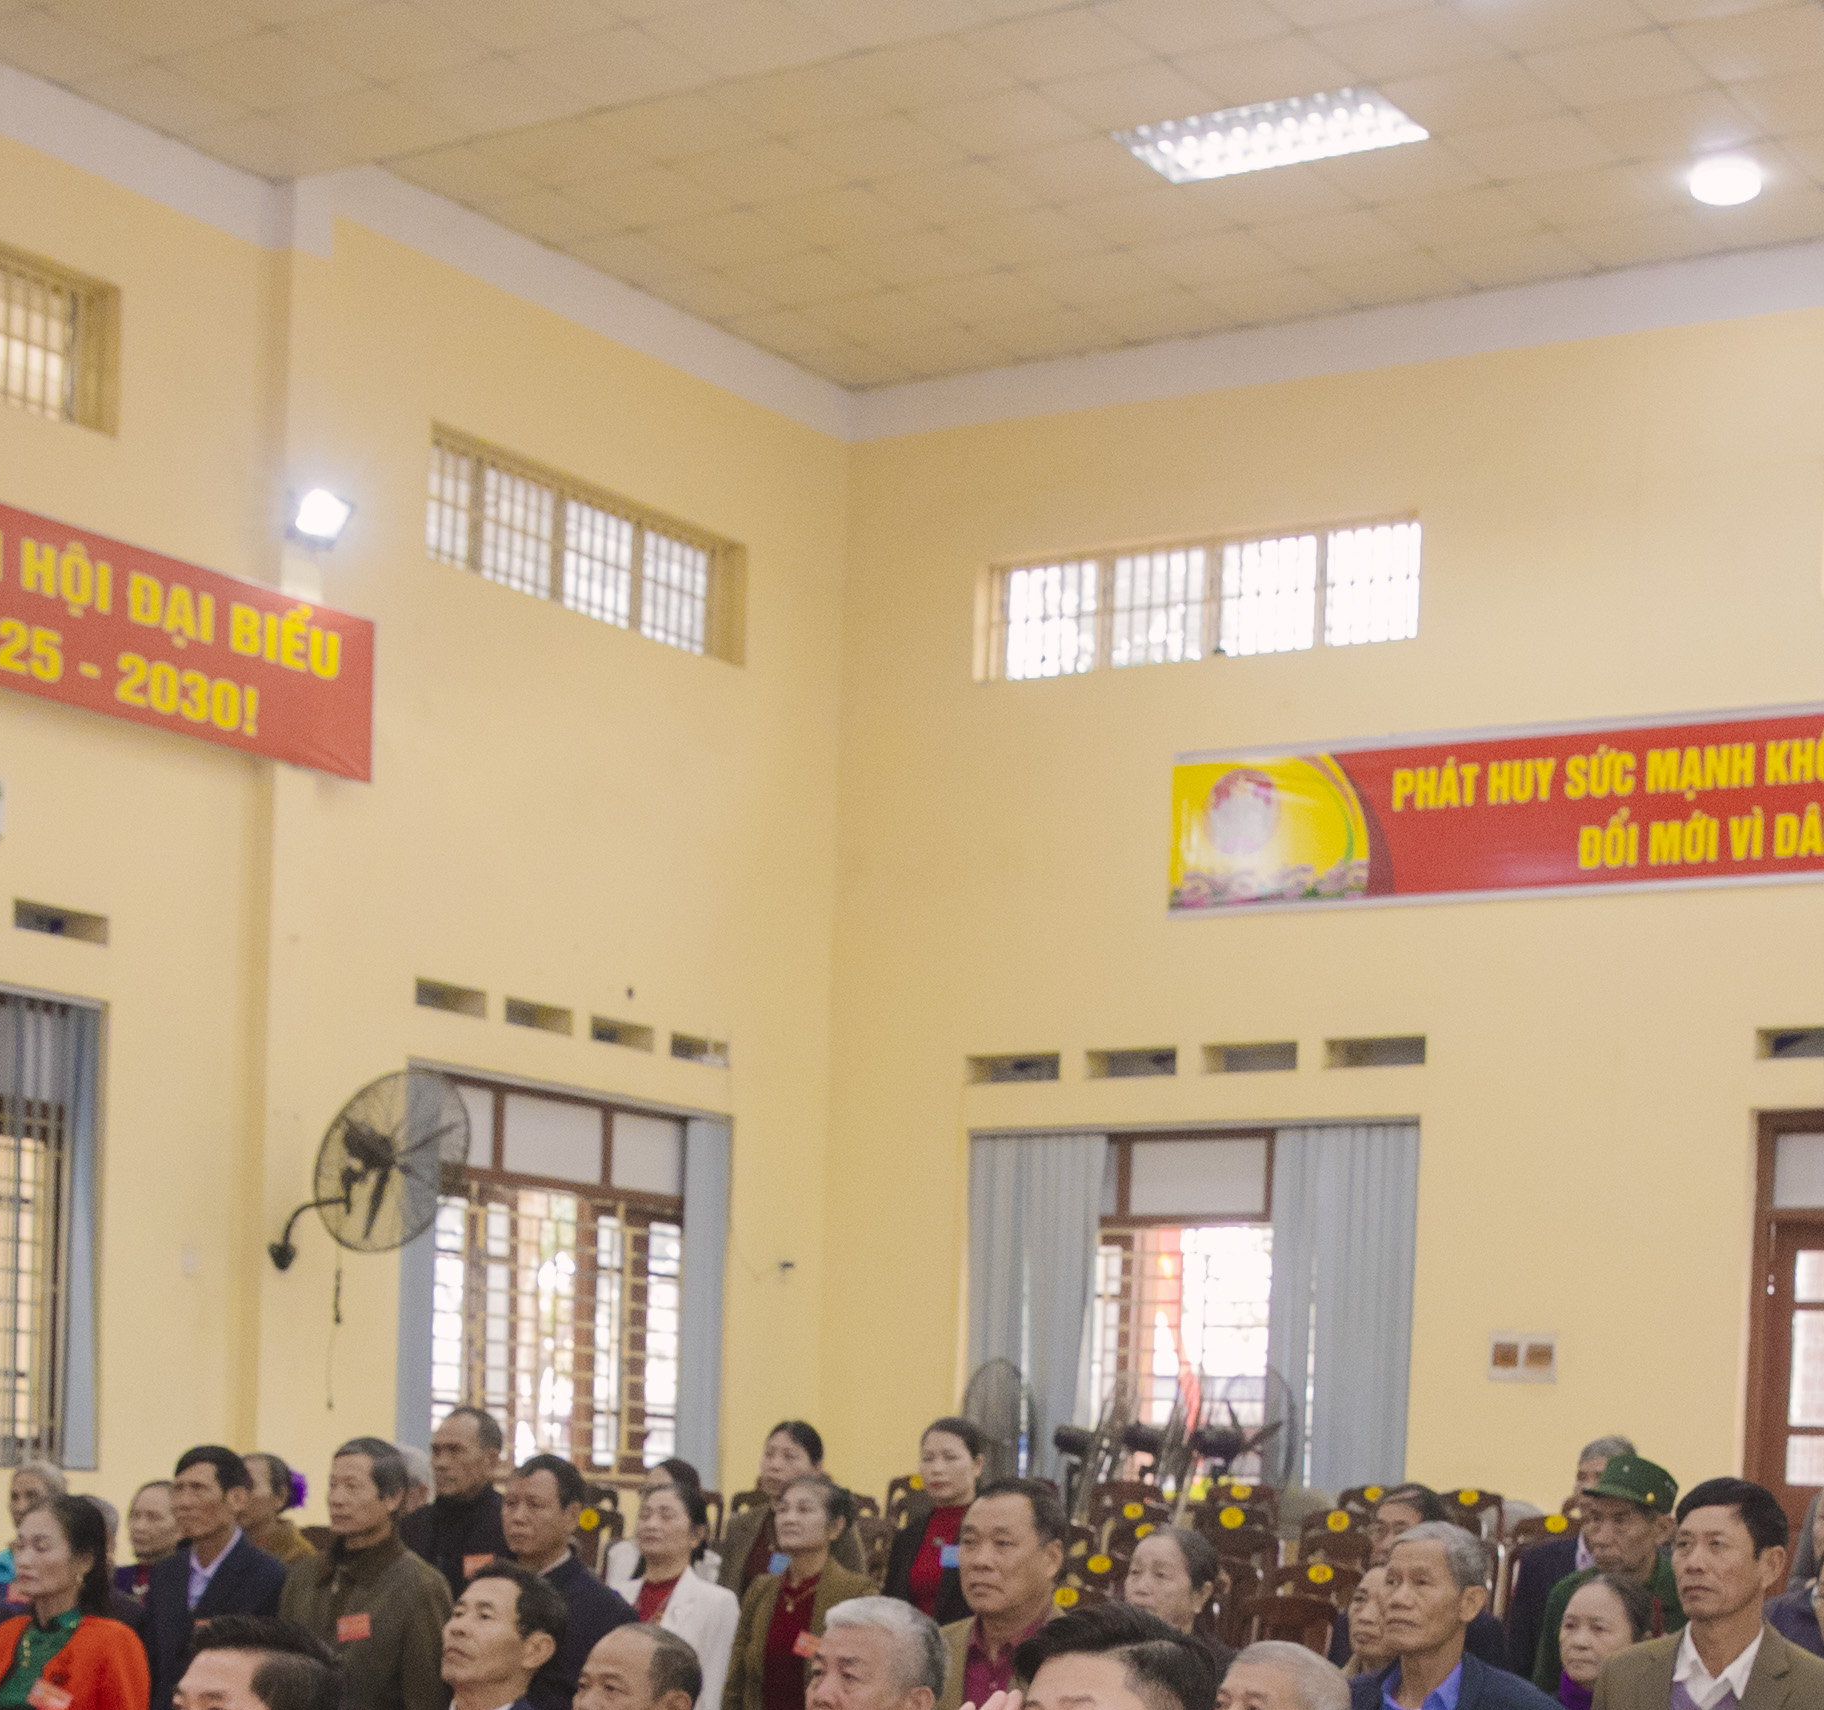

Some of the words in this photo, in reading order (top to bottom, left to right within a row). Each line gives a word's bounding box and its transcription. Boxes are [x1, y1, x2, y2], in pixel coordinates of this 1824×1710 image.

[21, 538, 112, 617] HỘI
[127, 571, 215, 649] ĐẠI
[230, 602, 342, 680] BIỂU
[115, 653, 257, 736] 2030!
[1392, 756, 1480, 811] PHÁT
[1487, 759, 1556, 804] HUY
[1564, 744, 1636, 799] SỨC
[1645, 743, 1755, 801] MẠNH
[1579, 807, 1638, 870] ĐỔI
[1649, 810, 1718, 865] MỚI
[1730, 806, 1762, 860] VÌ
